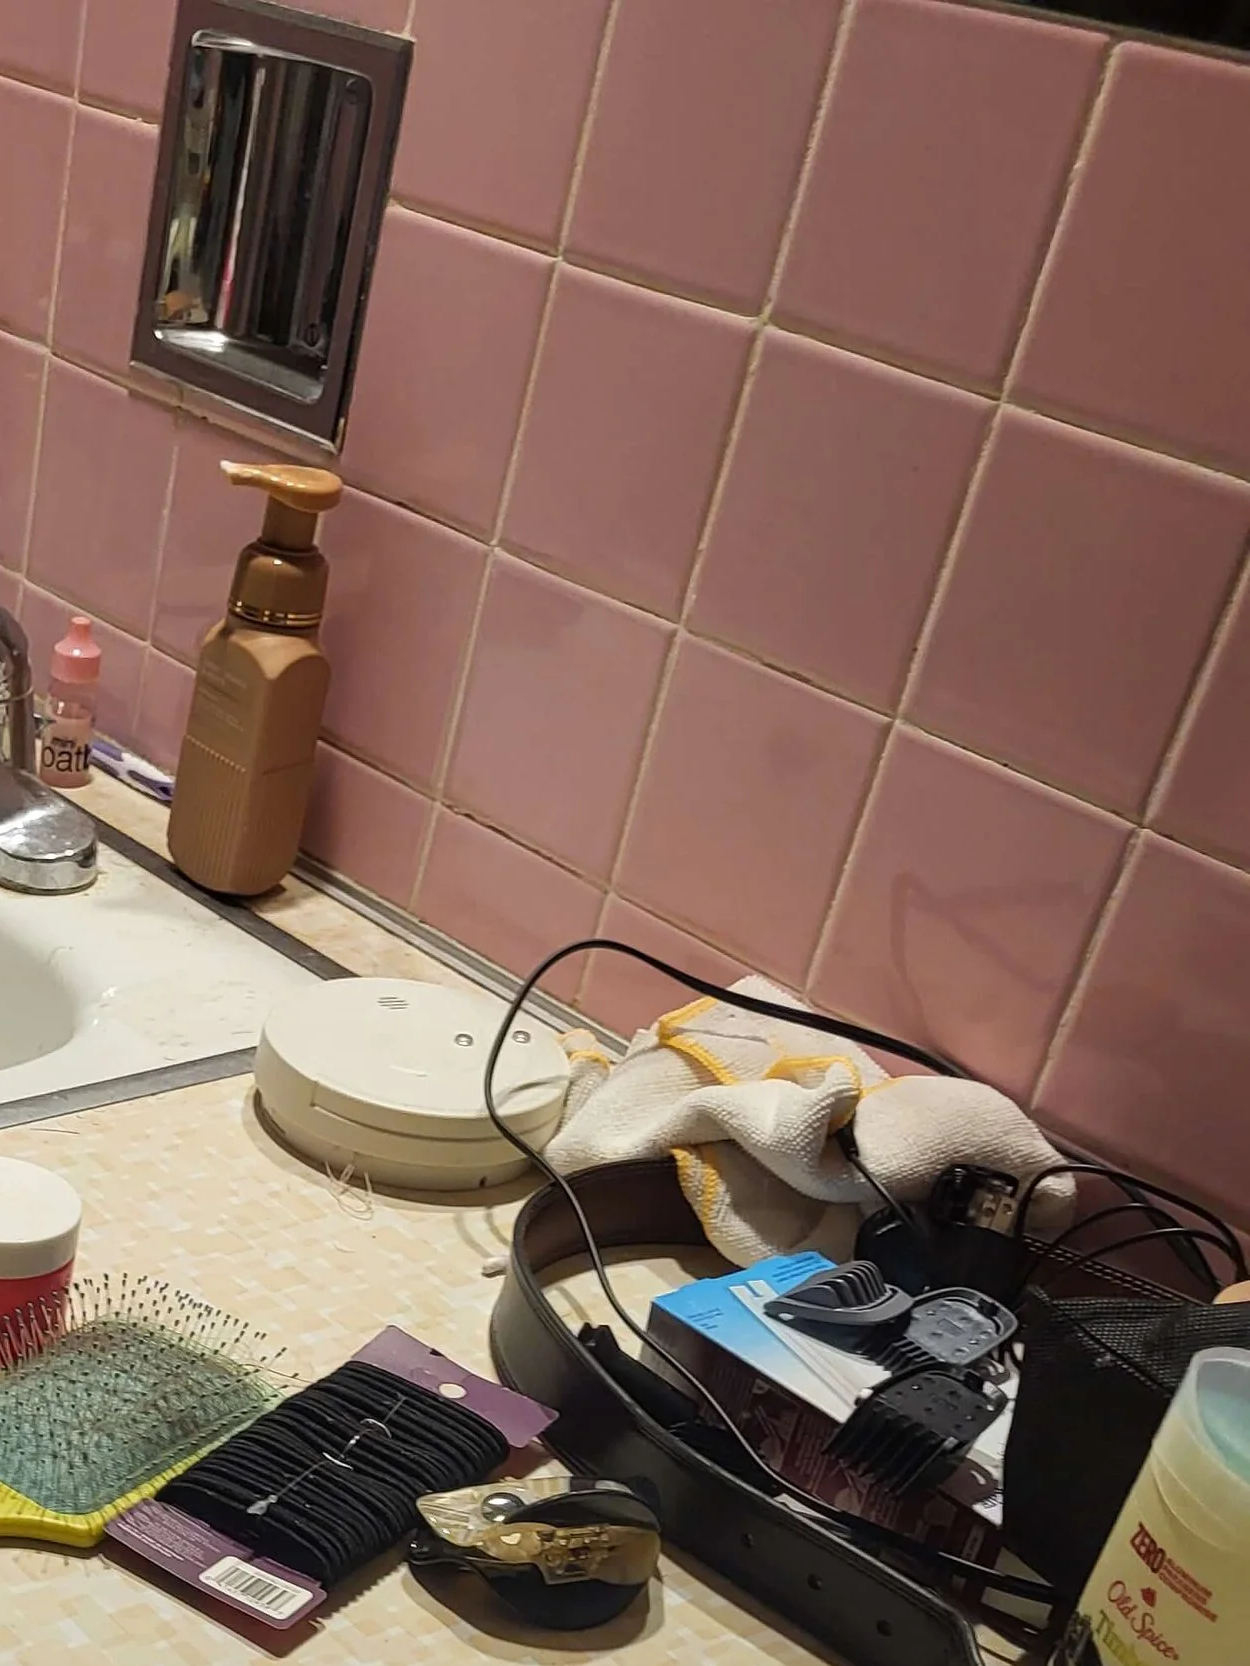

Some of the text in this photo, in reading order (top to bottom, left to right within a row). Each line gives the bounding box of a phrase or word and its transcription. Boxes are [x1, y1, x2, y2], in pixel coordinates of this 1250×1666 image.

[1129, 1521, 1167, 1574] ZERO
[1107, 1579, 1176, 1660] Old Spice
